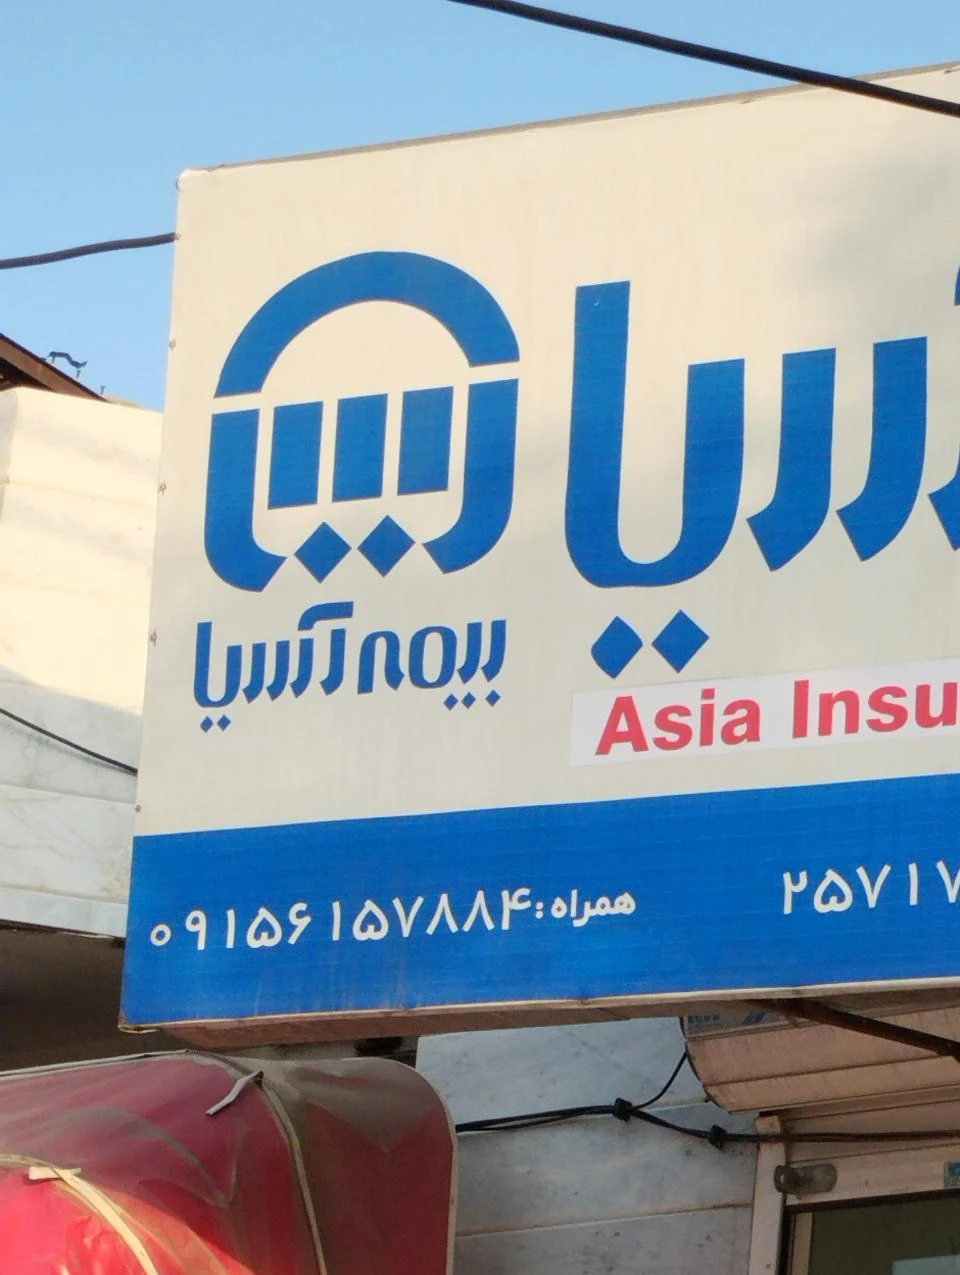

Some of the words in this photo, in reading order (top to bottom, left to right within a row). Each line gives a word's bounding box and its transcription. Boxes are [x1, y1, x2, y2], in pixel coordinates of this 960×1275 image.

[193, 600, 354, 734] آسیا
[357, 617, 508, 709] بیمه
[595, 687, 763, 757] Asia
